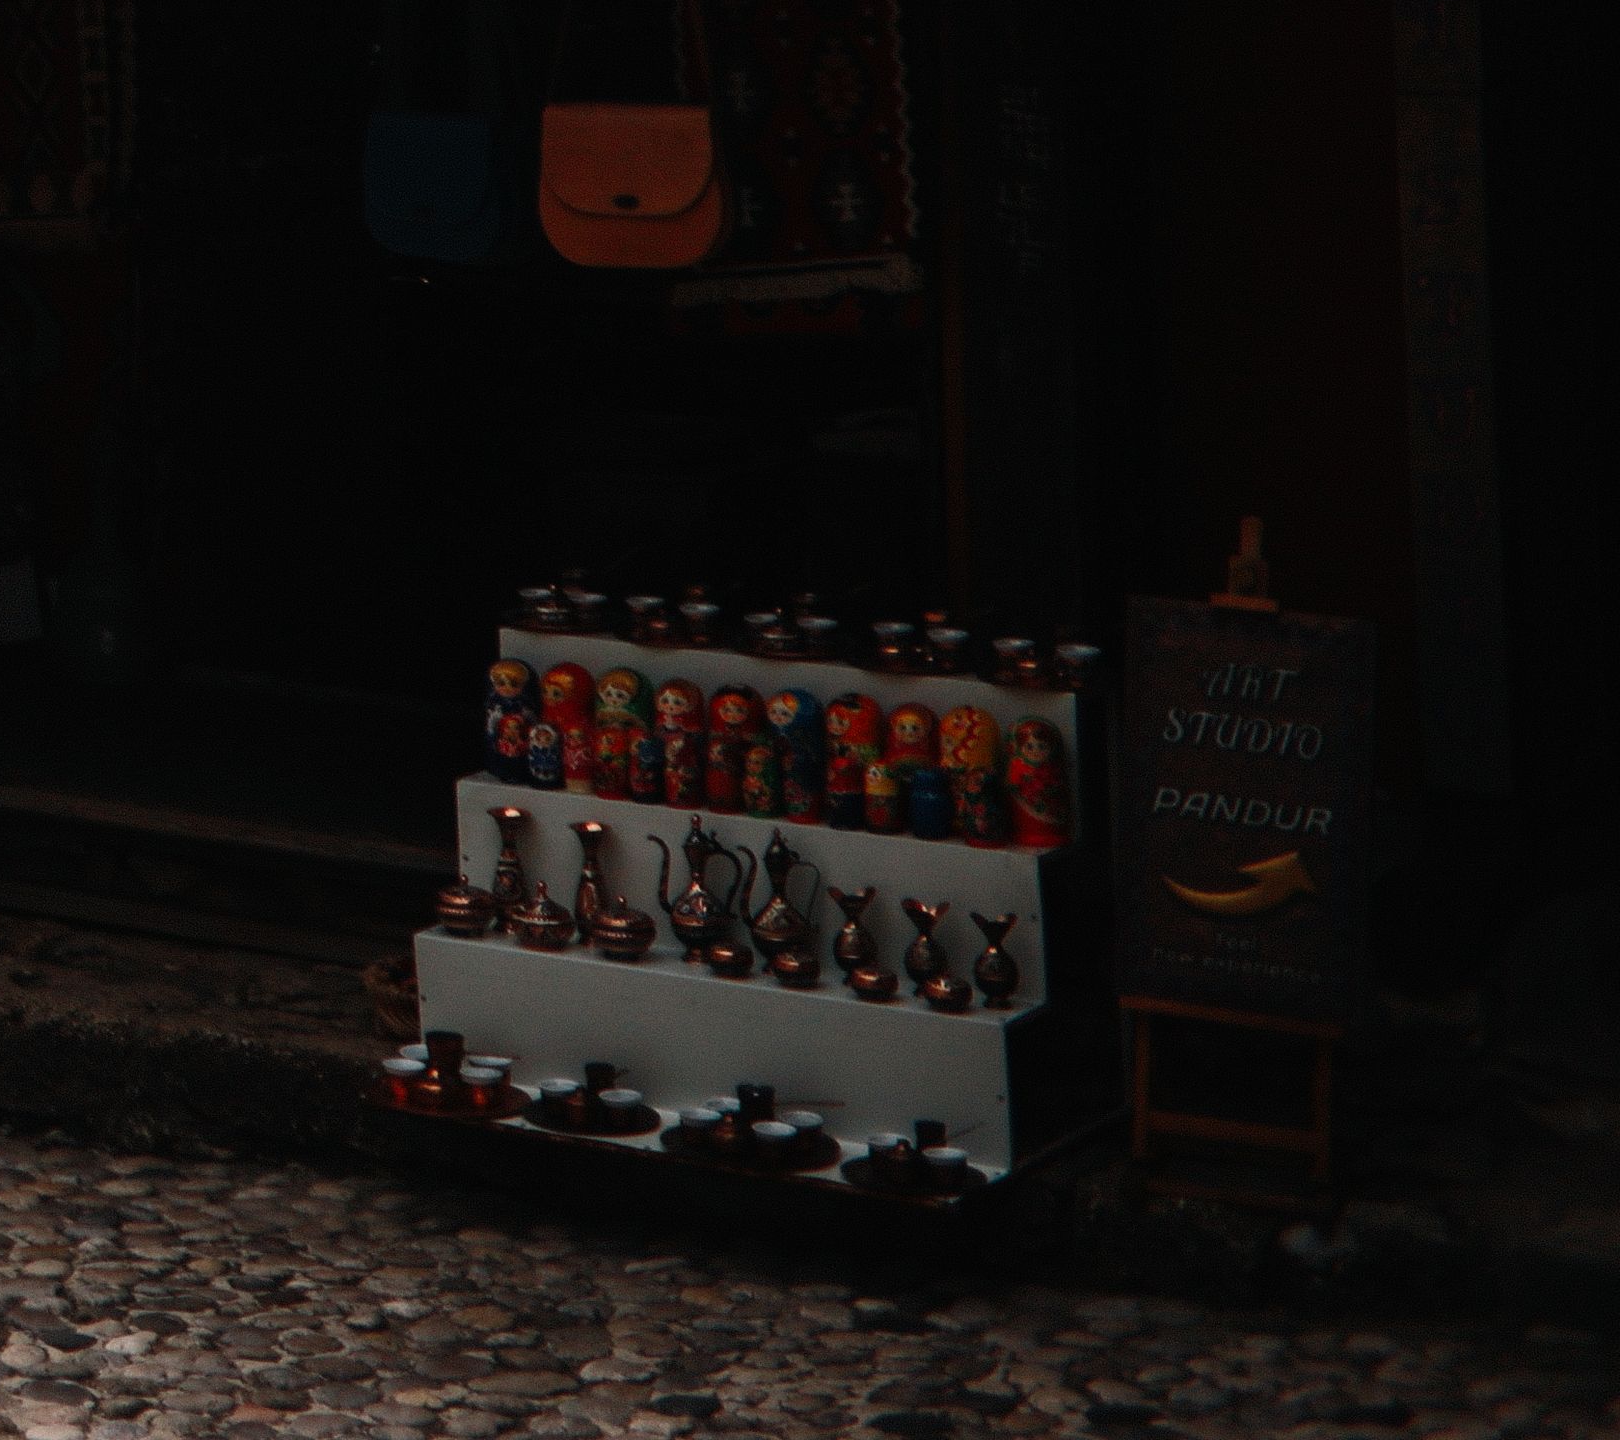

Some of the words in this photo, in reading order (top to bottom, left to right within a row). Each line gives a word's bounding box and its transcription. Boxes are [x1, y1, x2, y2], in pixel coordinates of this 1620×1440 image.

[1202, 660, 1300, 702] ART
[1160, 706, 1324, 762] STUDIO
[1151, 784, 1334, 838] PANDUR
